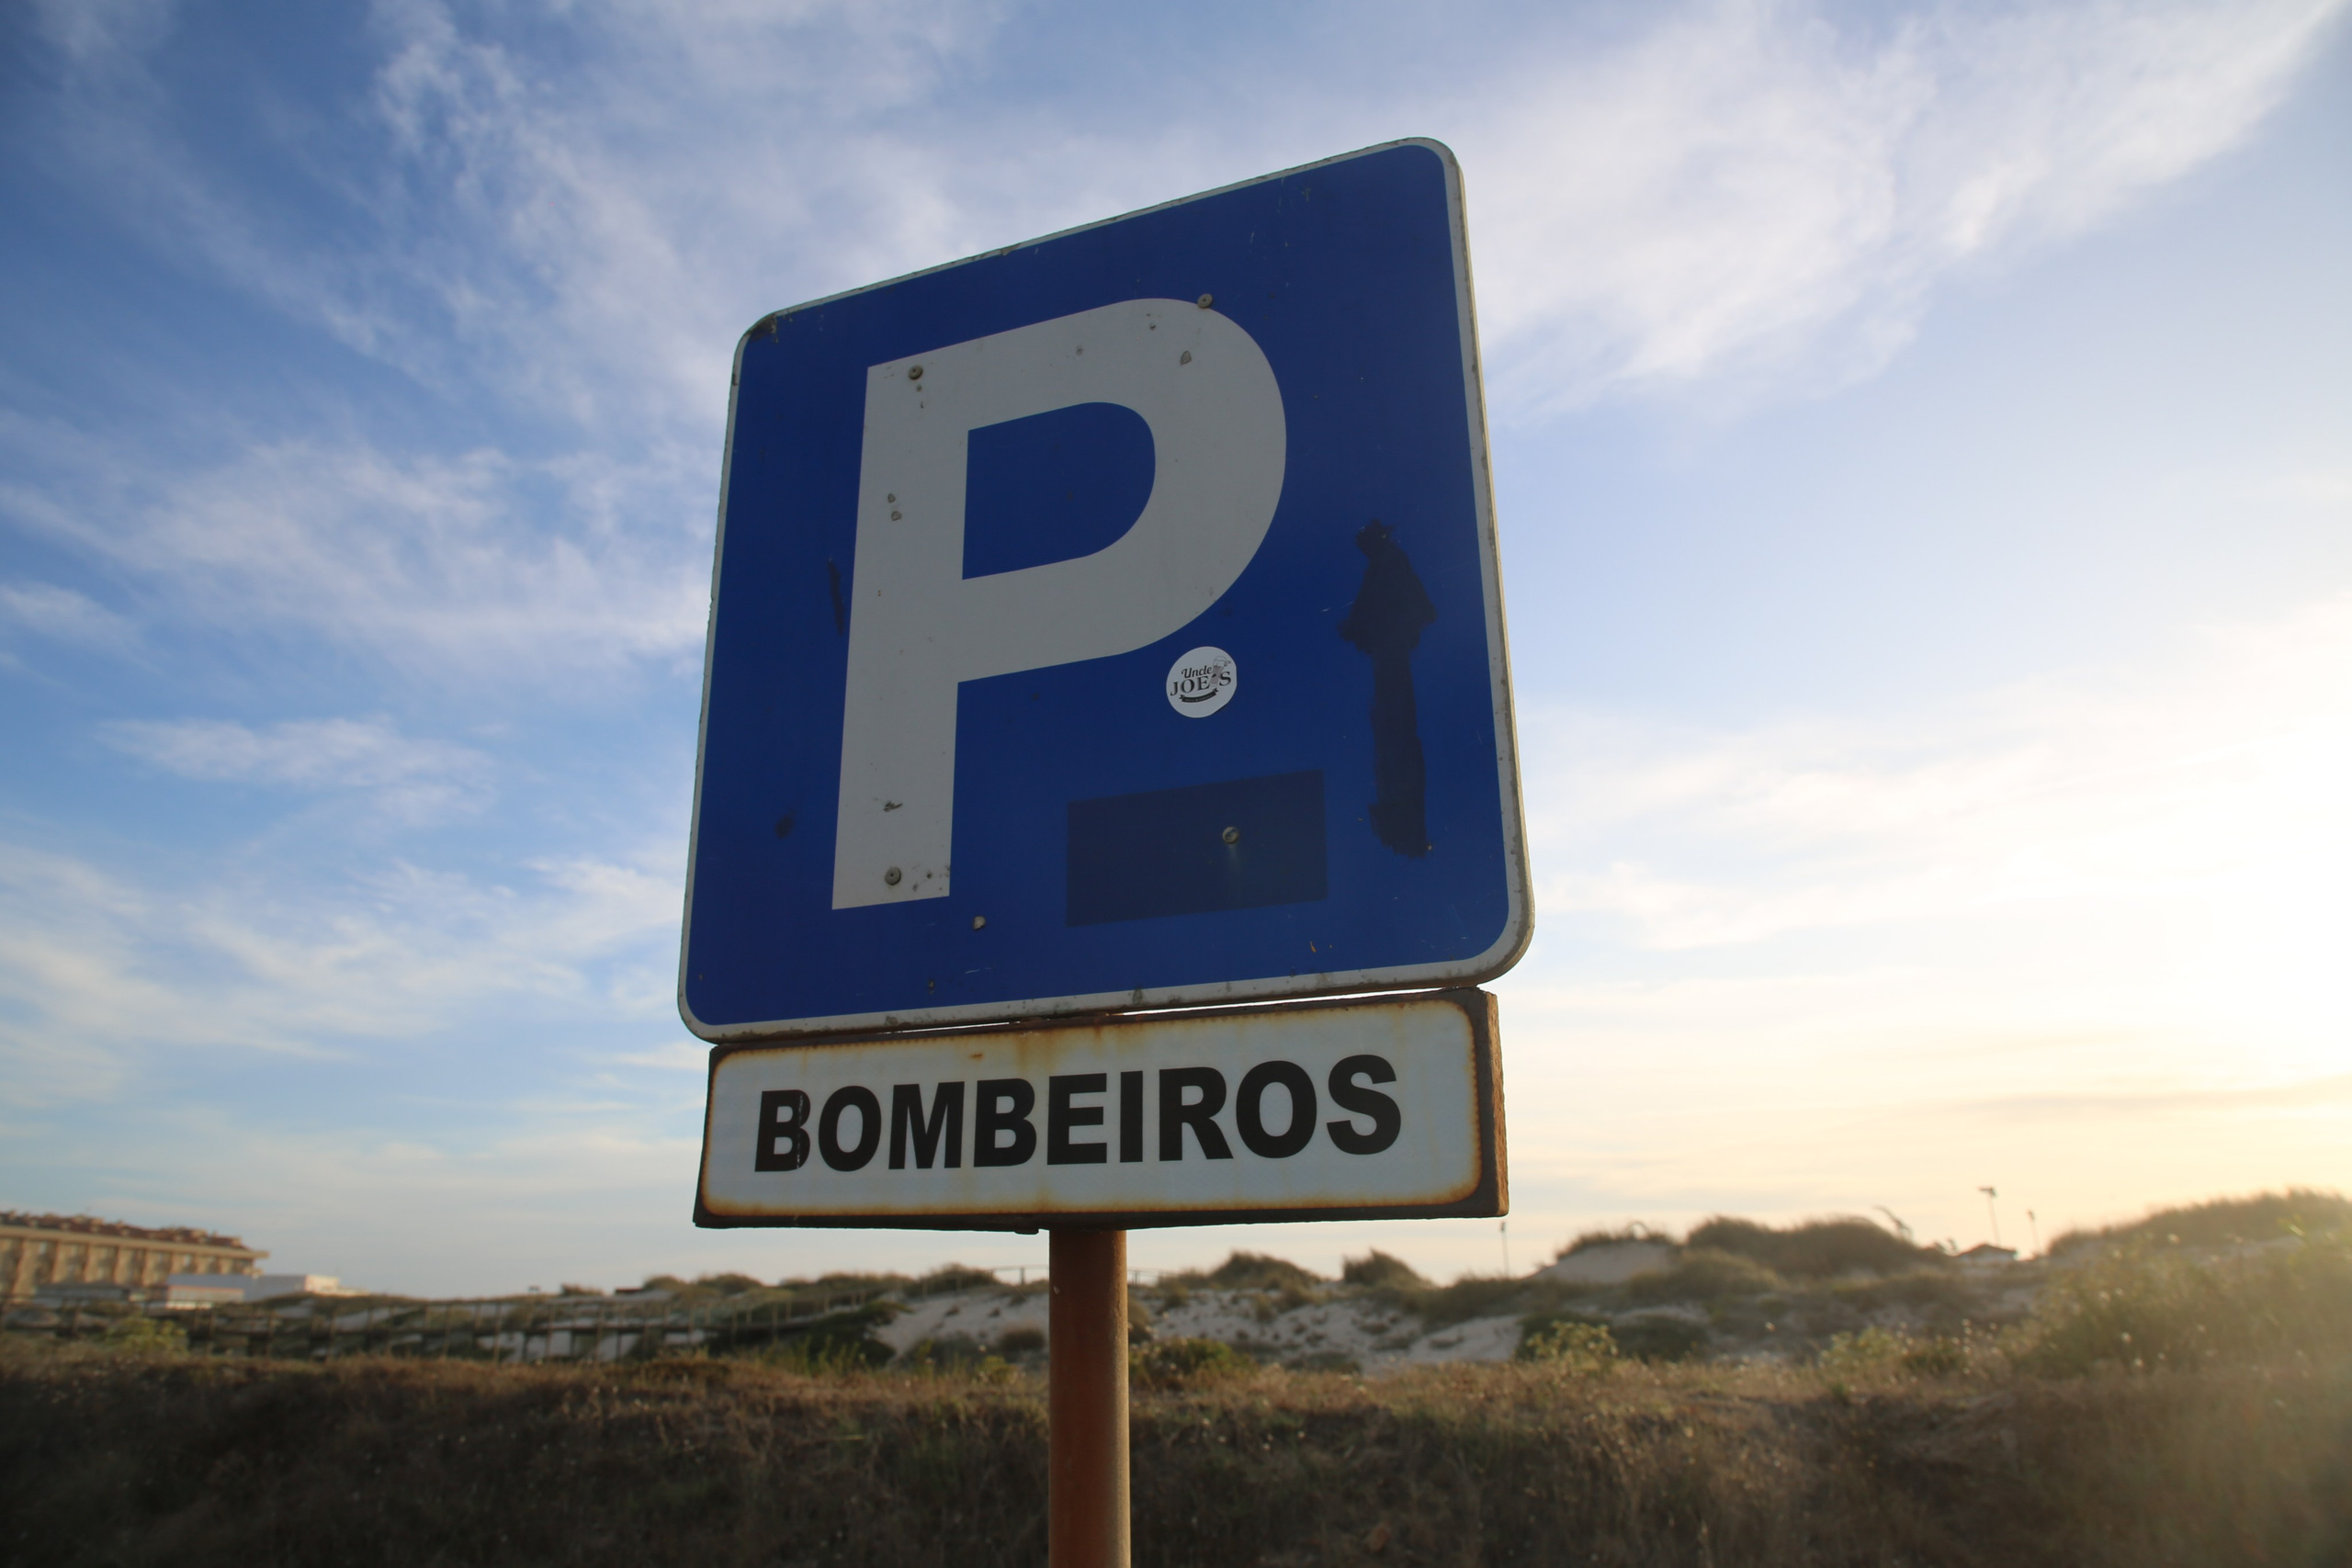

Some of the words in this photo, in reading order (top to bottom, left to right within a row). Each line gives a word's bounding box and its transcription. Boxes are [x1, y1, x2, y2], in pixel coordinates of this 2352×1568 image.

[831, 298, 1286, 911] P
[1182, 665, 1213, 678] Uncle
[754, 1054, 1402, 1172] BOMBEIROS
